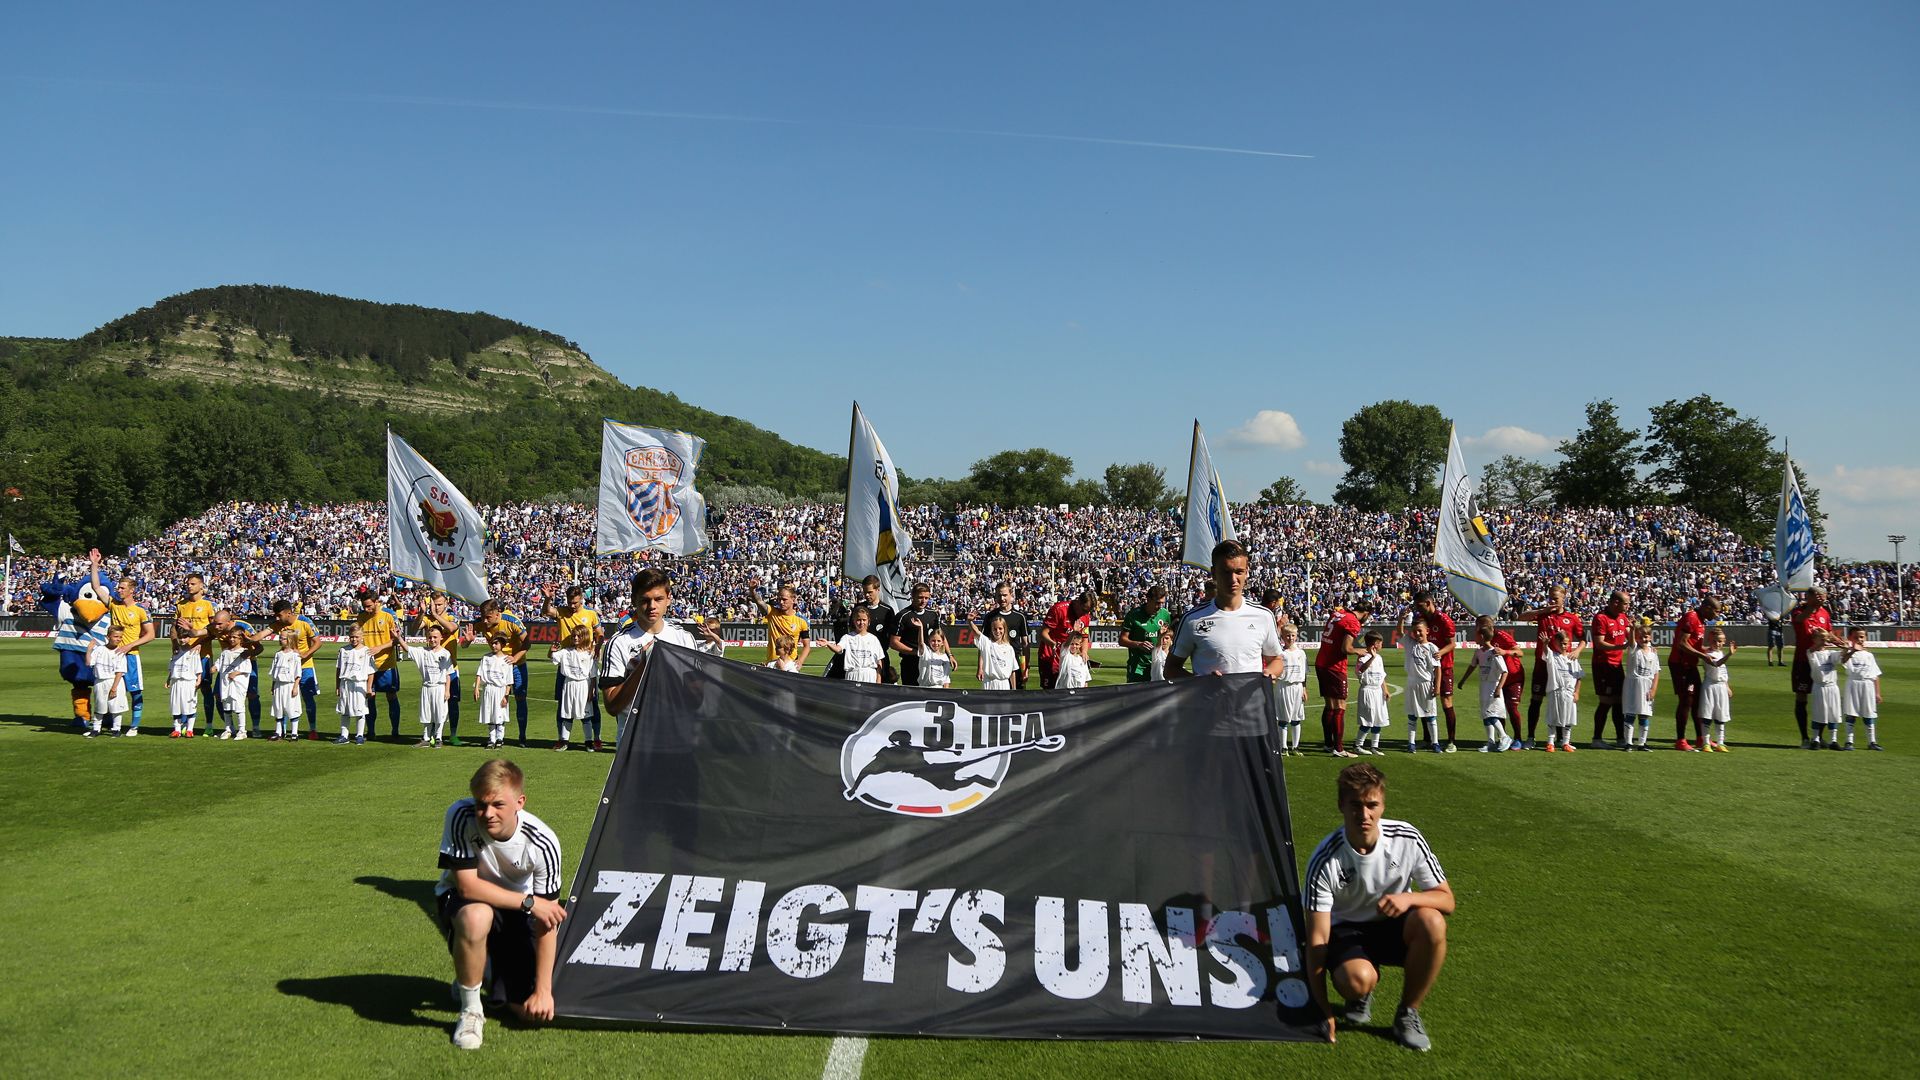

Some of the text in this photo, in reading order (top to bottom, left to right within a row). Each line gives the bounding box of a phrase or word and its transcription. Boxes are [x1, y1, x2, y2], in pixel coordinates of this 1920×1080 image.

[1459, 487, 1471, 534] FUSSBA
[529, 626, 561, 642] EAS
[924, 701, 1054, 750] 3. LIGA
[566, 870, 1310, 1009] ZEIGT'S UNS!
